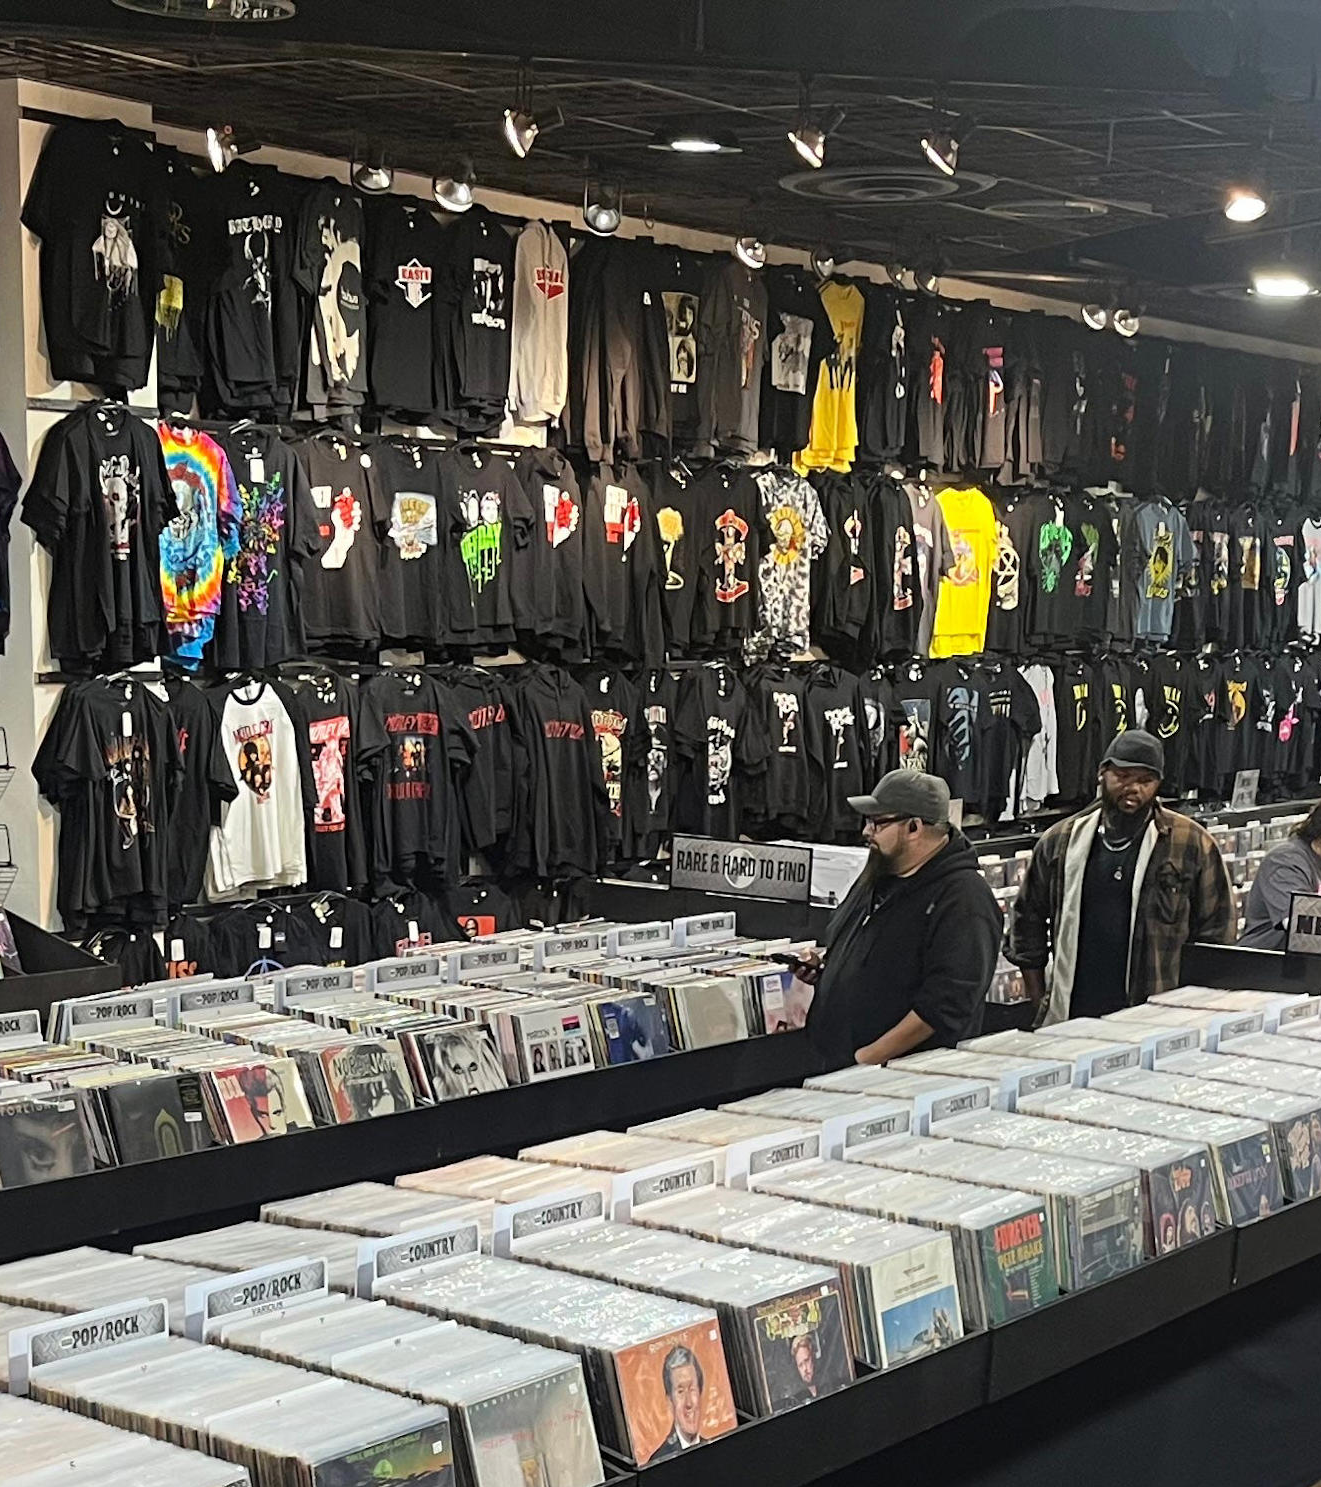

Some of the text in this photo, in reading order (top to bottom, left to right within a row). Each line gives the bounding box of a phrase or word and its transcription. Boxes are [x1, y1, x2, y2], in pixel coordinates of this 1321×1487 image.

[676, 850, 807, 883] RARE & HARD TO FIND
[96, 1001, 138, 1019] POP/ROCK
[658, 1169, 697, 1193] COUNTRY
[541, 1200, 583, 1226] COUNTRY
[409, 1236, 456, 1262] COUNTRY
[243, 1272, 302, 1304] POP/ROCK
[72, 1314, 140, 1349] POP/ROCK
